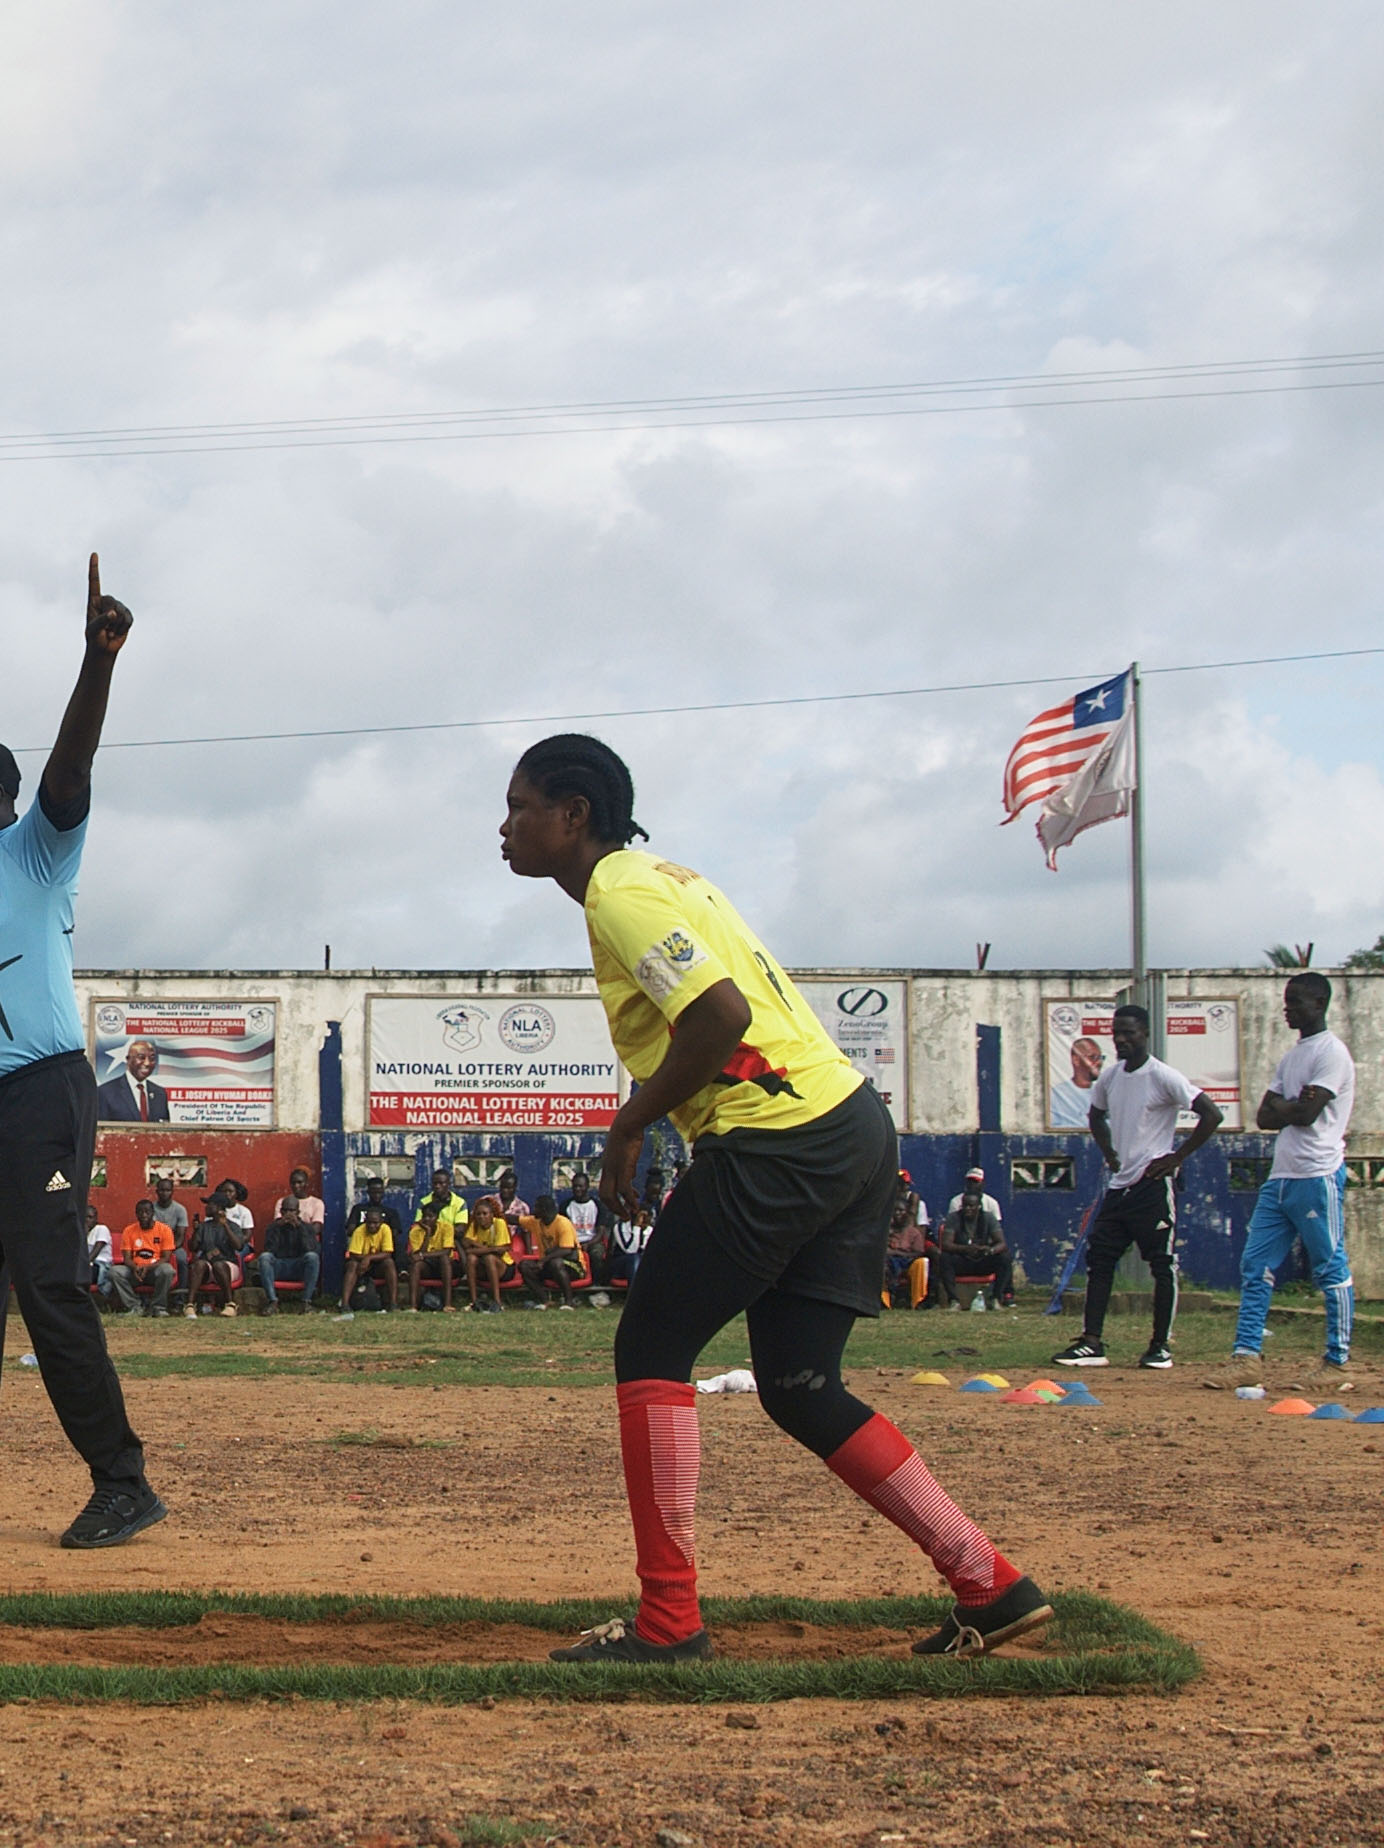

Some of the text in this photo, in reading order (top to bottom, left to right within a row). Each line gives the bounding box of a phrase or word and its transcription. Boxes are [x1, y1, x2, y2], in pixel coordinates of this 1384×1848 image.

[512, 1020, 542, 1031] NLA
[376, 1063, 614, 1076] NATIONAL LOTTERY AUTHORITY
[434, 1079, 546, 1088] PREMIER SPONSOR OF
[371, 1096, 619, 1110] THE NATIONAL LOTTERY KICKBALL
[406, 1112, 584, 1125] NATIONAL LEAGUE 2025
